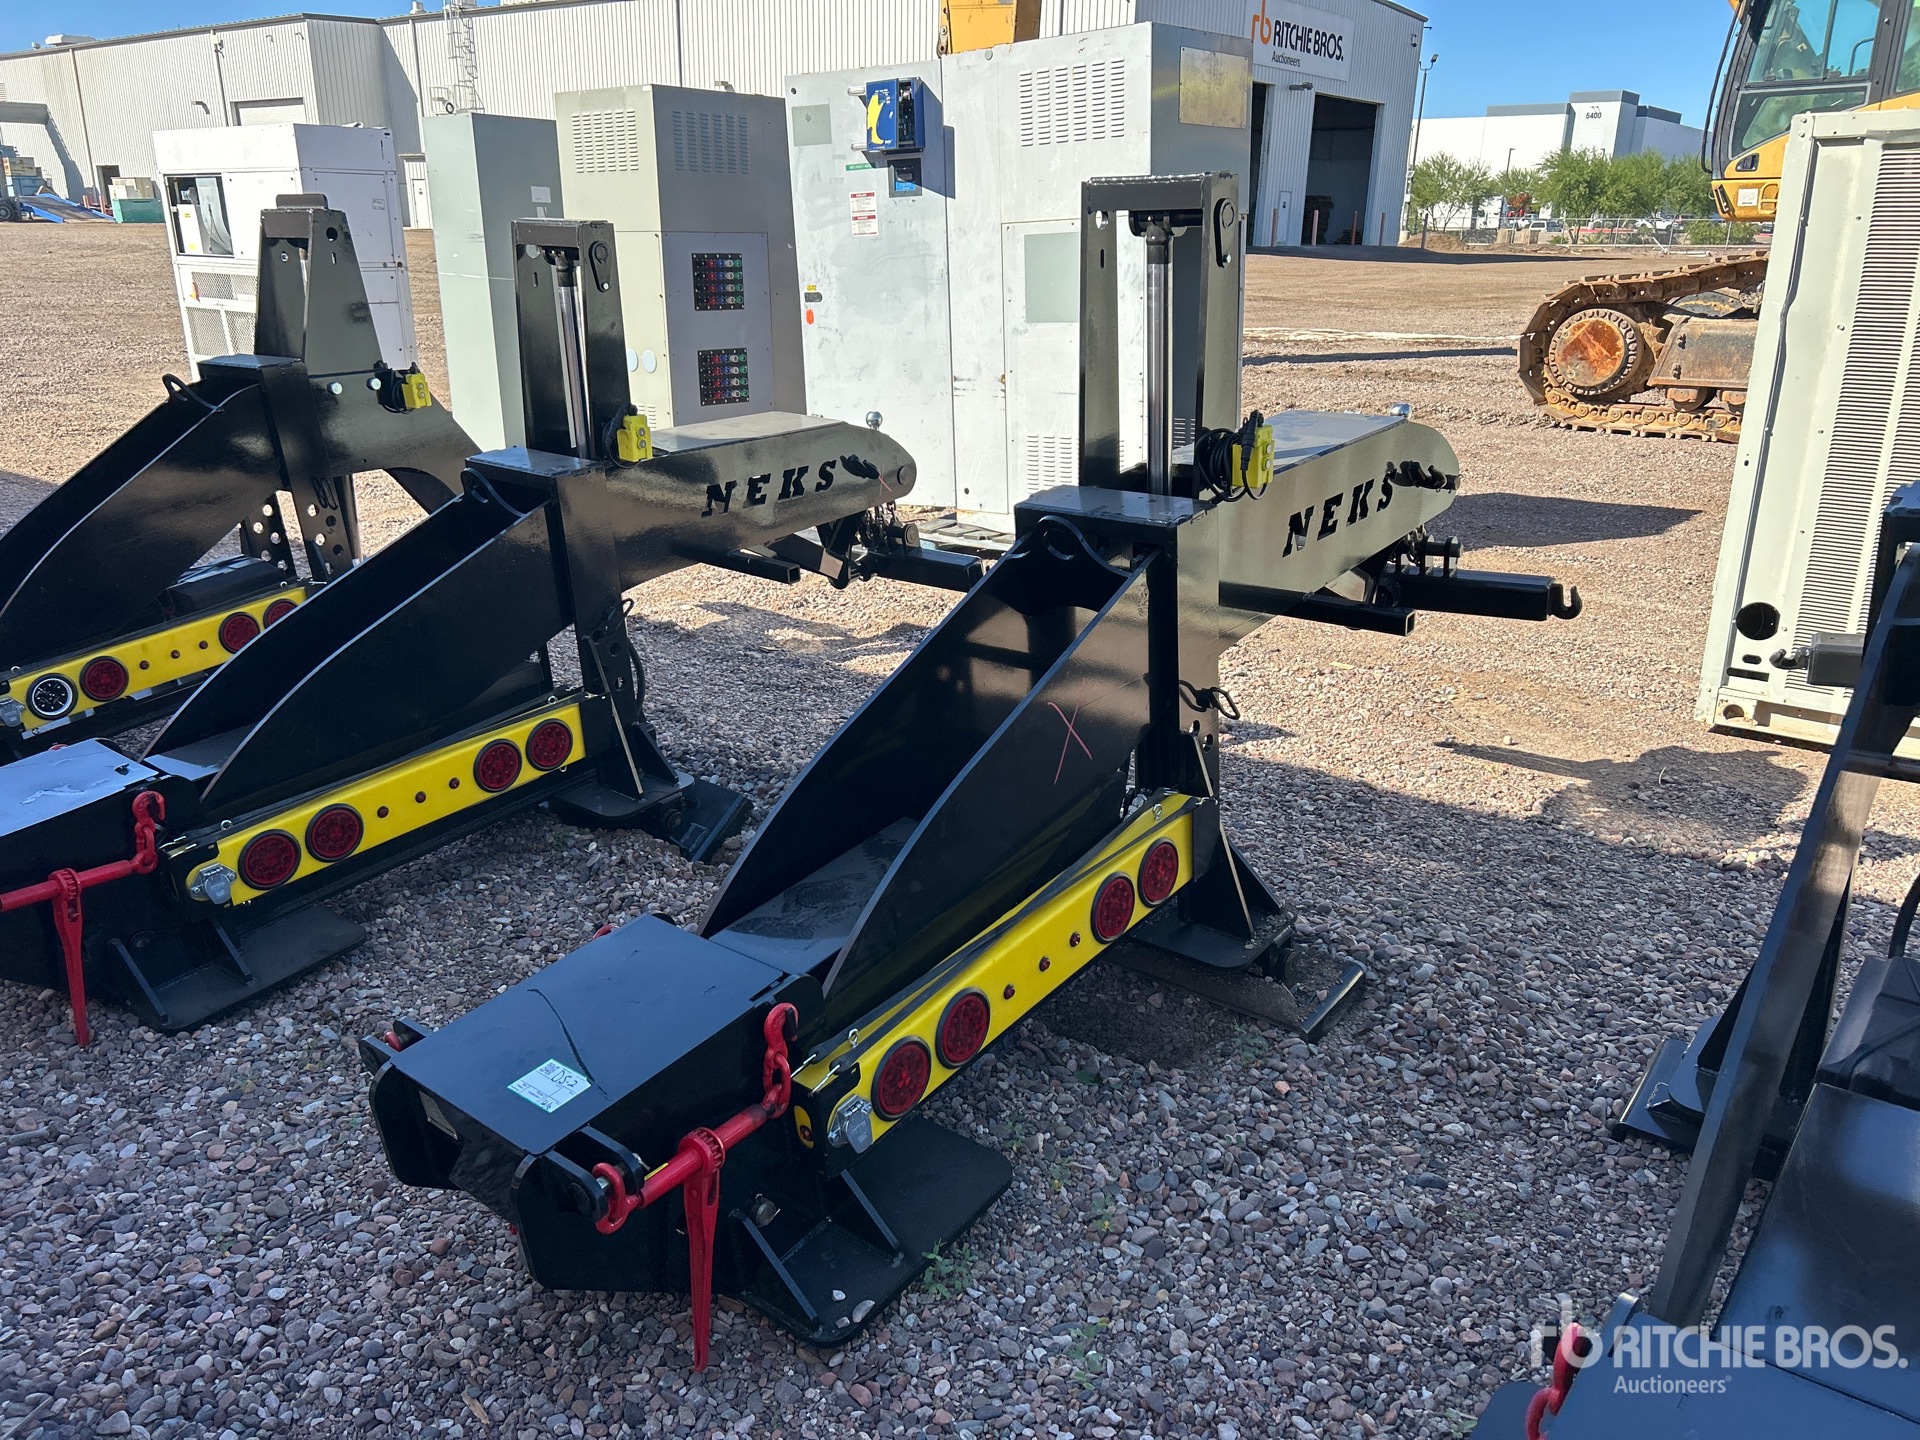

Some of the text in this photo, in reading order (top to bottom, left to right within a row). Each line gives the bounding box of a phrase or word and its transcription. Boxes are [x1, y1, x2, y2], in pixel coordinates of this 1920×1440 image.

[1271, 51, 1301, 67] Auctioneers
[1273, 20, 1313, 54] RITCHIE
[1313, 29, 1344, 61] BROS.
[701, 459, 837, 518] NEKS
[1282, 468, 1397, 558] NEKS
